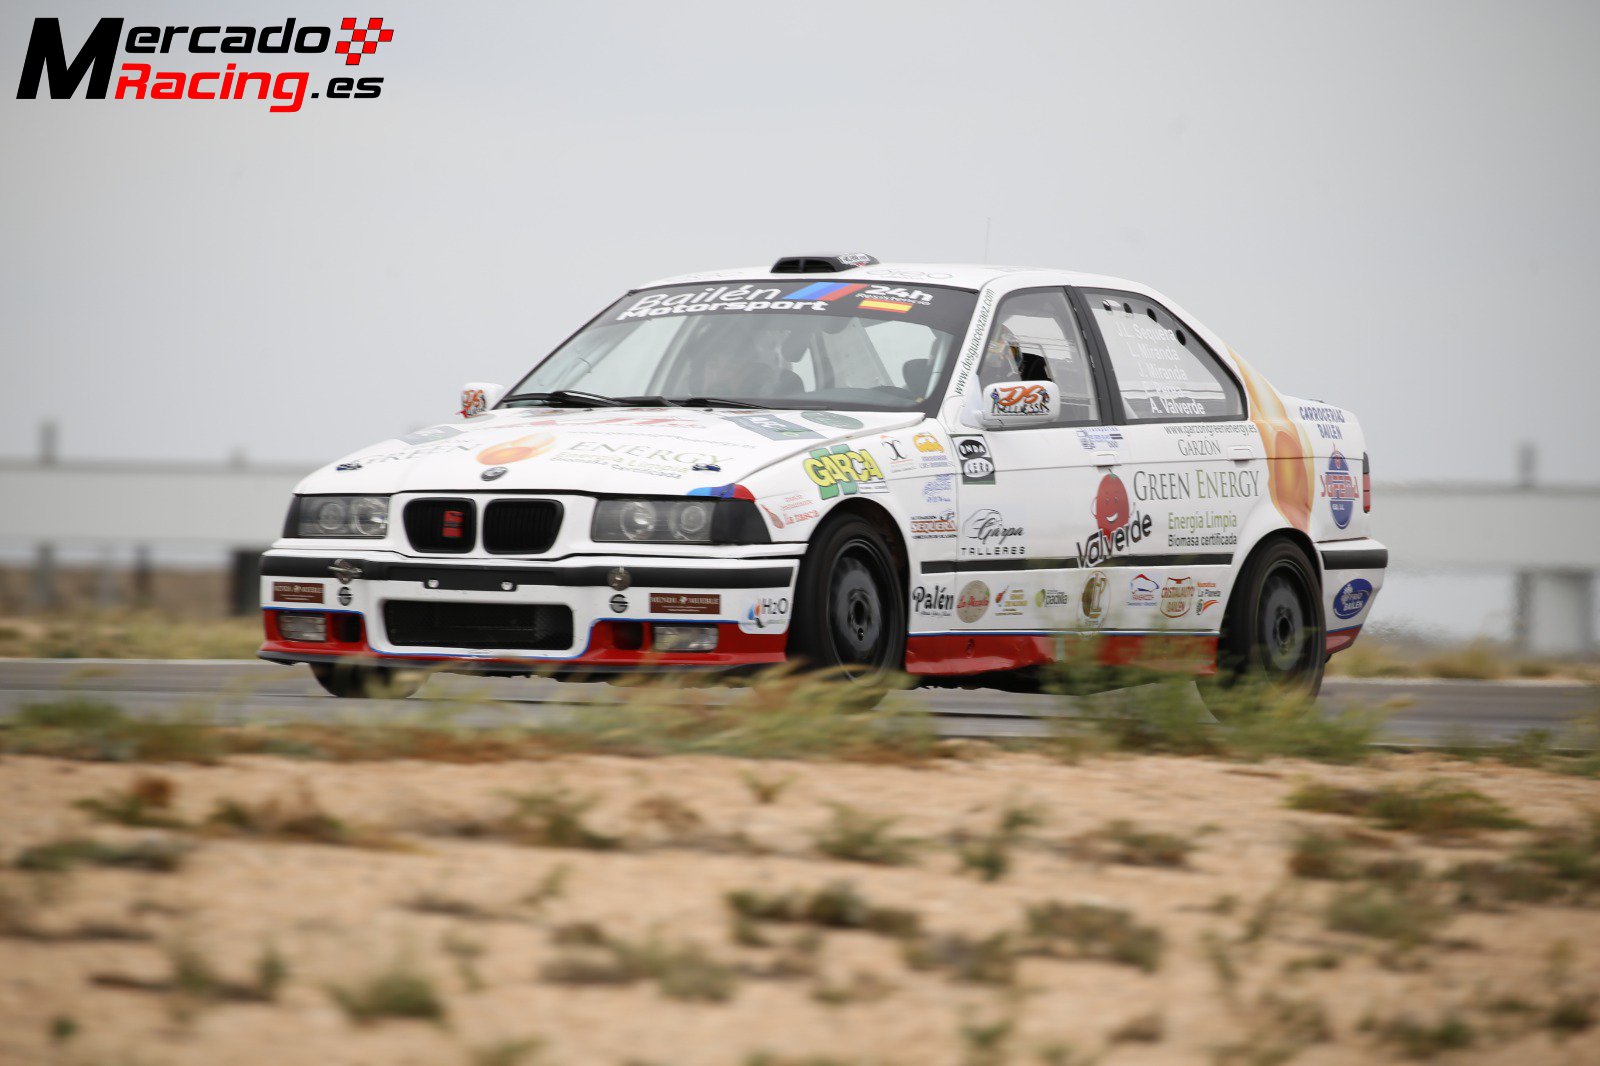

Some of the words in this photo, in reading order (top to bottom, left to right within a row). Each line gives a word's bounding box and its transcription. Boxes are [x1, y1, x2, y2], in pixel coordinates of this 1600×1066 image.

[630, 285, 782, 312] Bailén
[864, 284, 933, 302] 24h
[615, 299, 828, 321] Motorsport
[1137, 342, 1180, 360] Miranda
[1146, 362, 1188, 380] Miranda
[1149, 397, 1162, 414] A.
[1160, 397, 1206, 415] Valverde
[803, 449, 884, 487] GARCA
[1133, 470, 1191, 501] GREEN
[1195, 469, 1260, 499] ENERGY
[1206, 511, 1237, 533] Limpia
[1076, 509, 1153, 568] Valverde
[1167, 533, 1200, 547] Biomasa
[1201, 532, 1237, 547] certificada
[961, 546, 1026, 555] TALLERES
[912, 585, 954, 612] Palén
